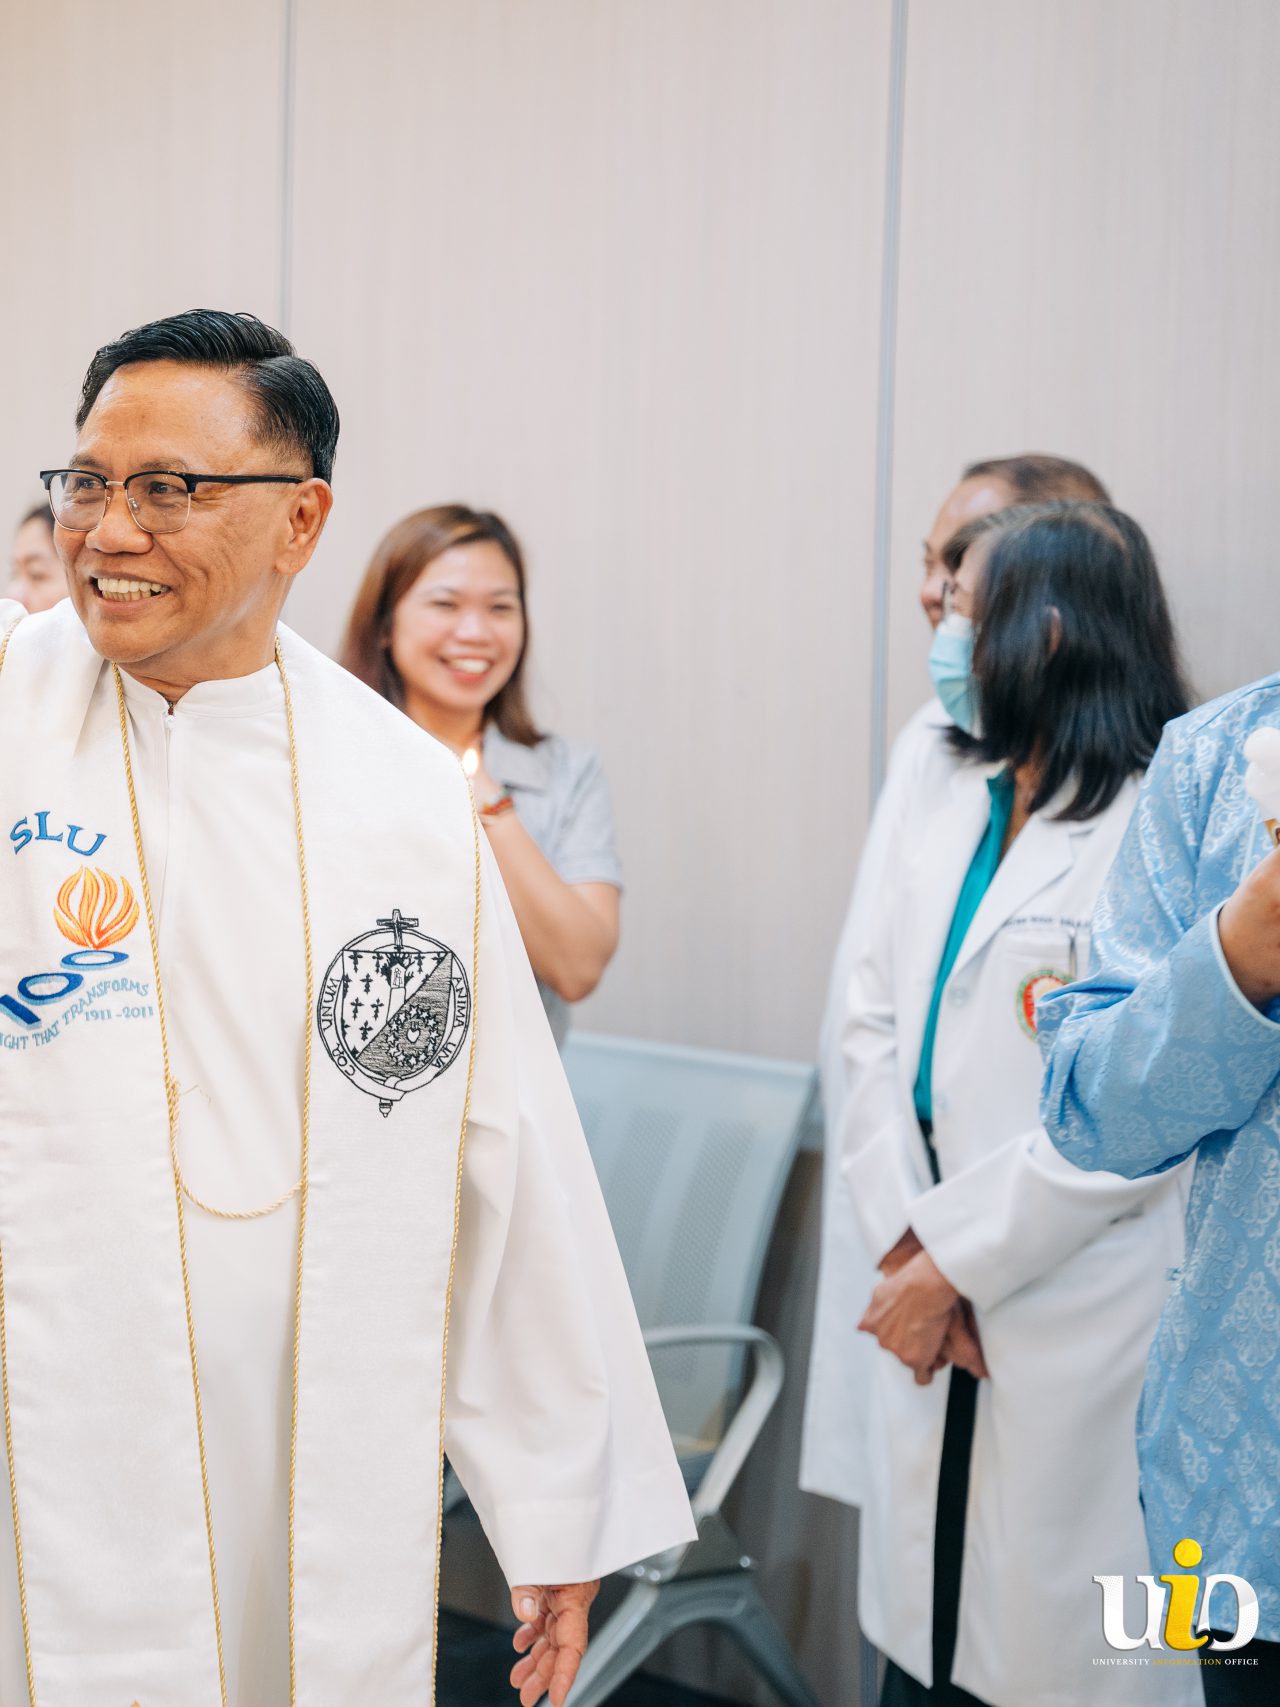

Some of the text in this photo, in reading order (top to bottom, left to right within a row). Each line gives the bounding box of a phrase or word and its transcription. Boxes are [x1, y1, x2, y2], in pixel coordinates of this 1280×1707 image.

[10, 811, 108, 856] SLU
[32, 1020, 61, 1047] THAT
[62, 977, 149, 1025] TRANSFORMS
[321, 977, 356, 1076] COR UNUM
[431, 977, 467, 1069] ANIMA UNA
